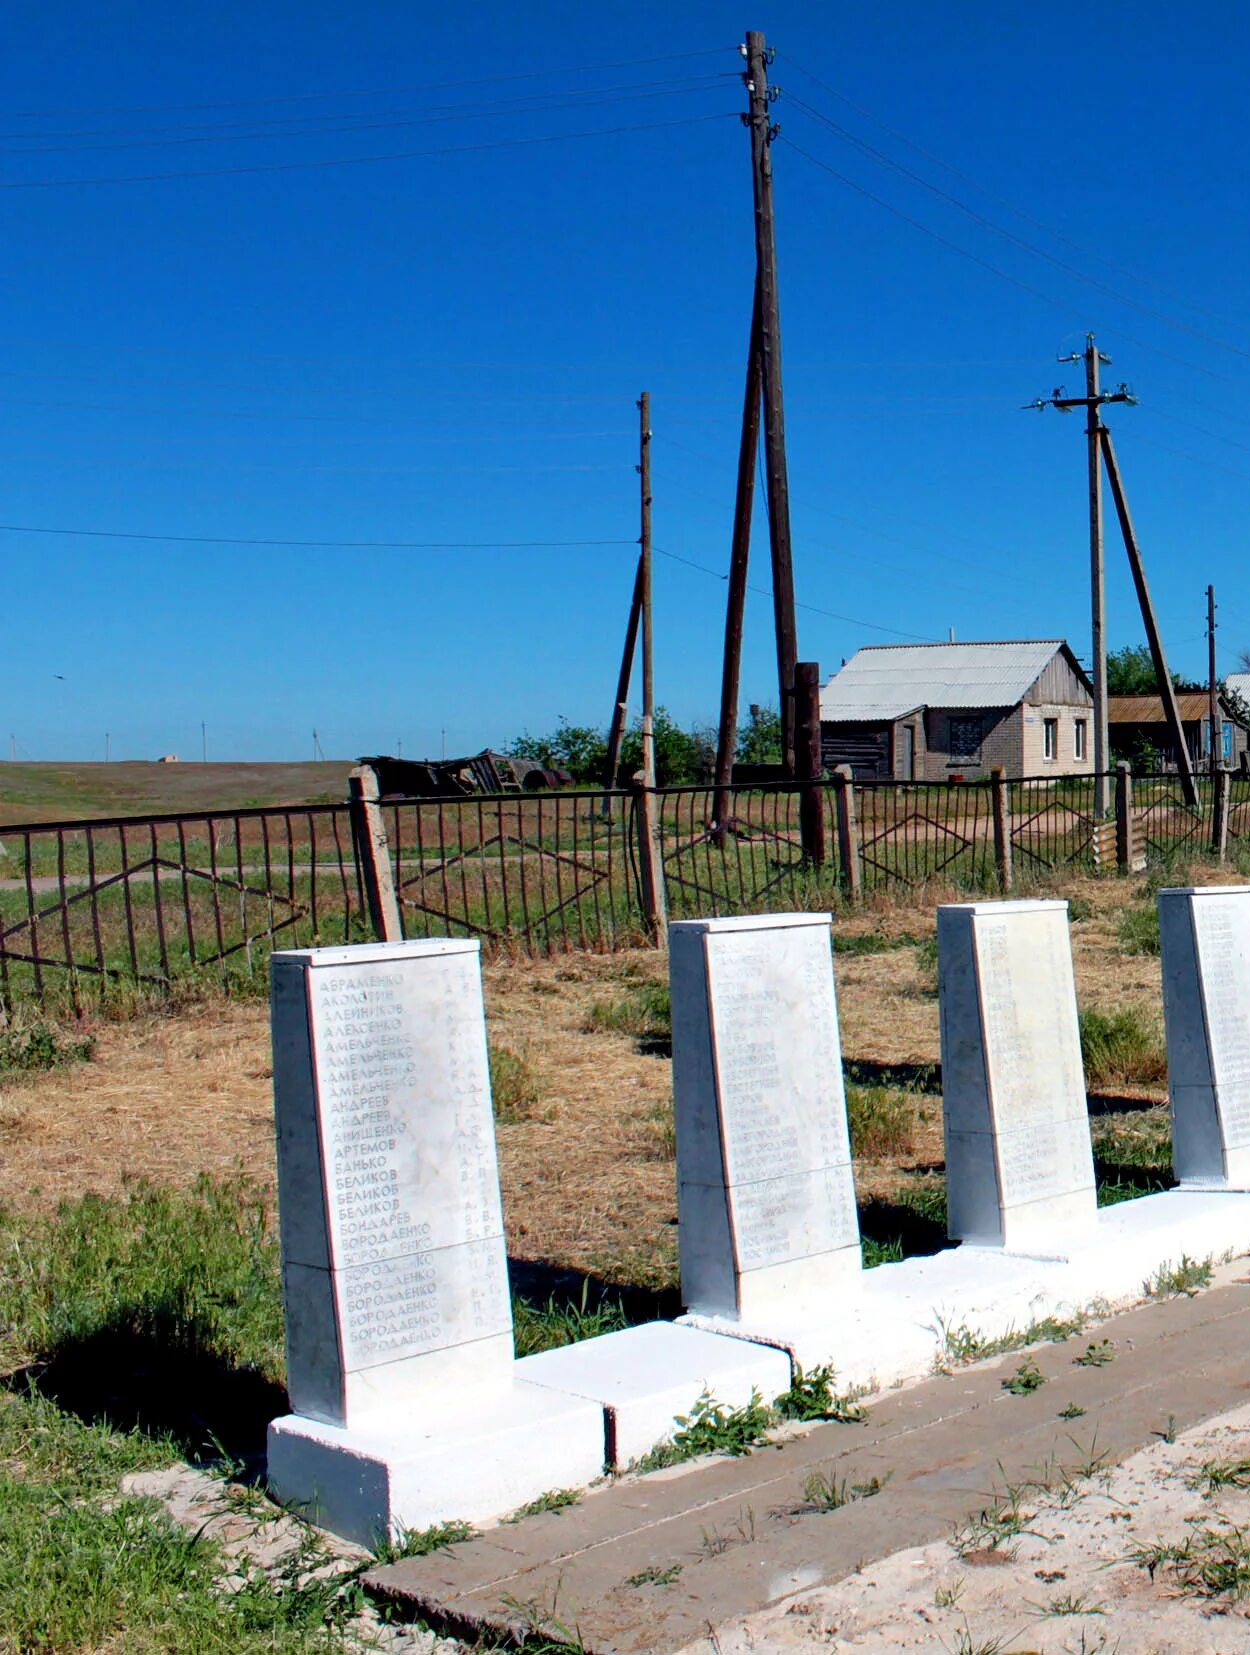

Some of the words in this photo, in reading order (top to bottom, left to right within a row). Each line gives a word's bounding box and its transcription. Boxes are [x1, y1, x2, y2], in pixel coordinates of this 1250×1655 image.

[320, 974, 404, 993] АВРАМЕНКО
[324, 1018, 401, 1038] АЛЕКСЕНКО
[327, 1046, 414, 1068] АМЕЛЬЧЕНКО
[331, 1095, 389, 1113] АНДРЕЕВ
[331, 1110, 391, 1129] АНДРЕЕВ
[334, 1138, 396, 1159] АРТЕМОВ
[335, 1155, 387, 1175] БАНЬКО
[336, 1169, 398, 1190] БЕЛИКОВ
[337, 1183, 400, 1205] БЕЛИКОВ
[339, 1198, 401, 1221] БЕЛИКОВ
[340, 1211, 411, 1235] БОНДАРЕВ
[342, 1221, 432, 1251] БОРОДАЕНКО
[343, 1236, 433, 1265] БОРОДЕНКО
[345, 1253, 434, 1282] БОРОДКО
[361, 1326, 441, 1353] ОРОДАЕНКО
